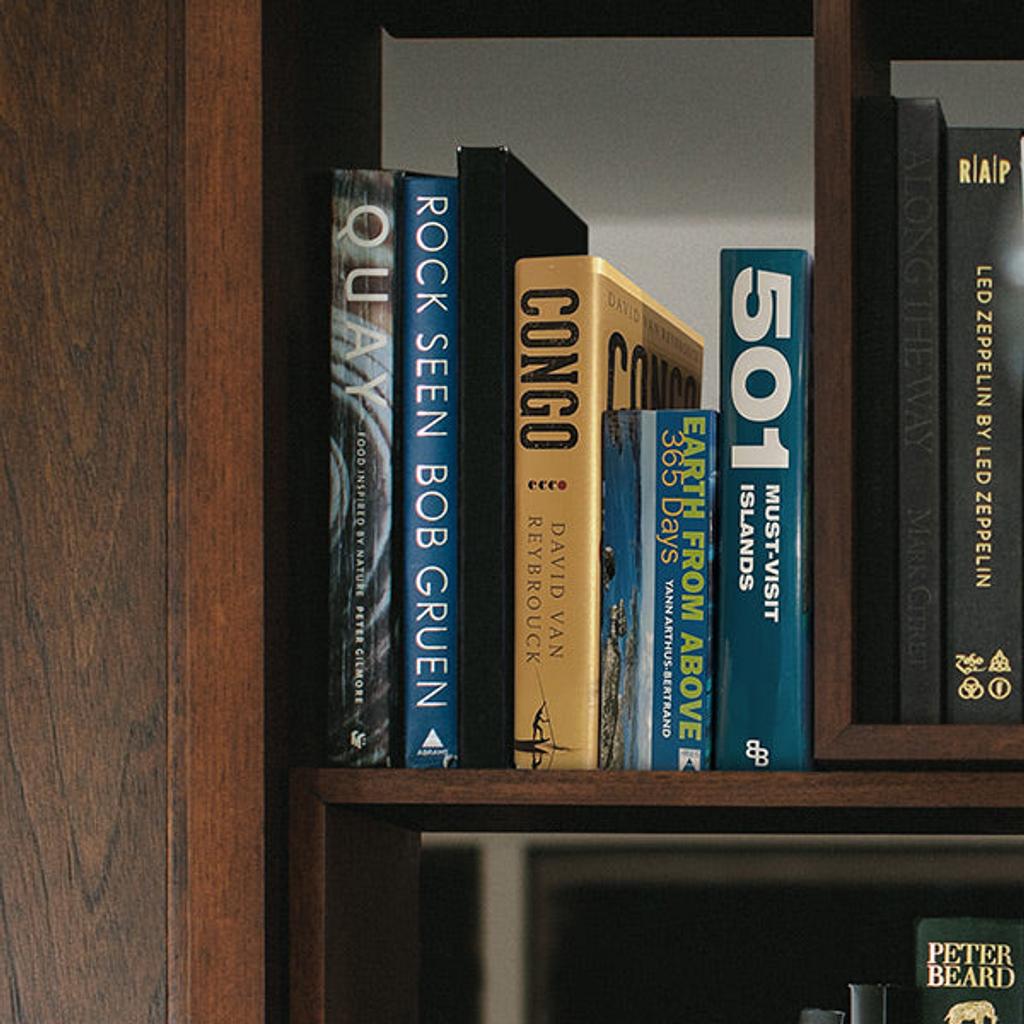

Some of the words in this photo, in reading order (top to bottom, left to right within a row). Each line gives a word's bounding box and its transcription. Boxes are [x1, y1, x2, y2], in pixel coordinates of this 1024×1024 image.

[415, 196, 449, 314] ROCK
[976, 265, 993, 304] LED
[337, 204, 390, 407] QUAY
[415, 333, 449, 438] SEEN
[520, 288, 580, 450] CONGO
[730, 266, 792, 470] 501
[976, 310, 993, 407] ZEPPELIN
[661, 429, 686, 487] 365
[683, 416, 707, 519] EARTH
[976, 414, 993, 440] BY
[976, 446, 992, 485] LED
[356, 471, 367, 526] INSPIRED
[415, 464, 449, 549] BOB
[656, 497, 685, 564] Days
[739, 484, 755, 592] ISLANDS
[976, 491, 992, 589] ZEPPELIN
[355, 553, 366, 597] NATURE
[525, 516, 544, 665] REYBROUCK
[549, 522, 567, 599] DAVID
[663, 578, 675, 614] YANN
[681, 531, 705, 621] FROM
[763, 483, 781, 624] MUST-VISIT
[355, 605, 366, 644] PETER
[415, 565, 449, 708] GRUEN
[549, 610, 565, 659] VAN
[354, 648, 365, 705] GILMORE
[661, 615, 675, 739] ARTHUS-BERTRAND
[679, 631, 705, 742] ABOVE
[927, 941, 1014, 966] PETER
[927, 964, 1016, 989] BEARD
